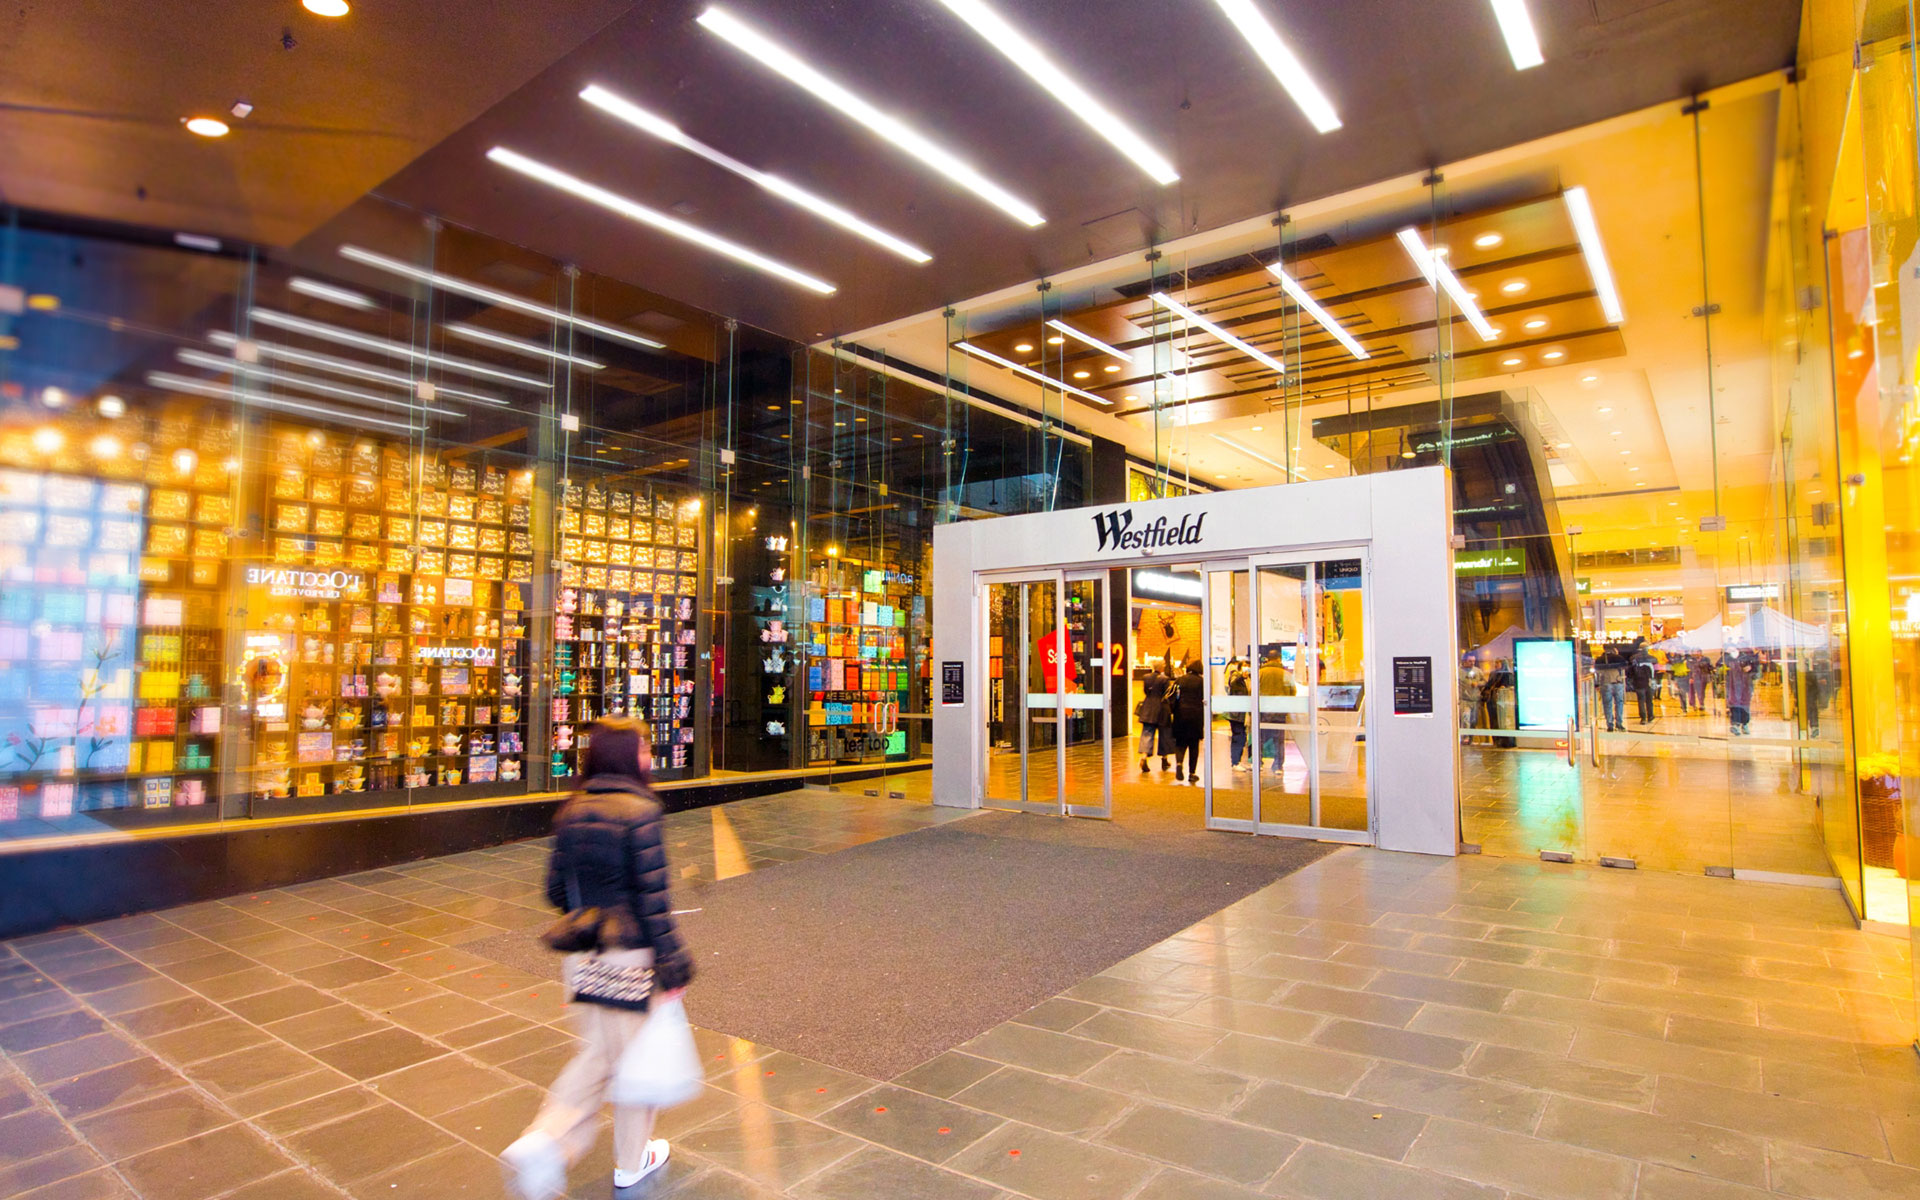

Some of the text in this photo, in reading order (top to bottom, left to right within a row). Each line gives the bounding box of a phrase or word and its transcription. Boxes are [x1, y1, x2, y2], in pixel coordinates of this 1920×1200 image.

[1091, 508, 1208, 552] Westfield
[1047, 648, 1067, 664] Sae
[844, 737, 890, 753] tea too
